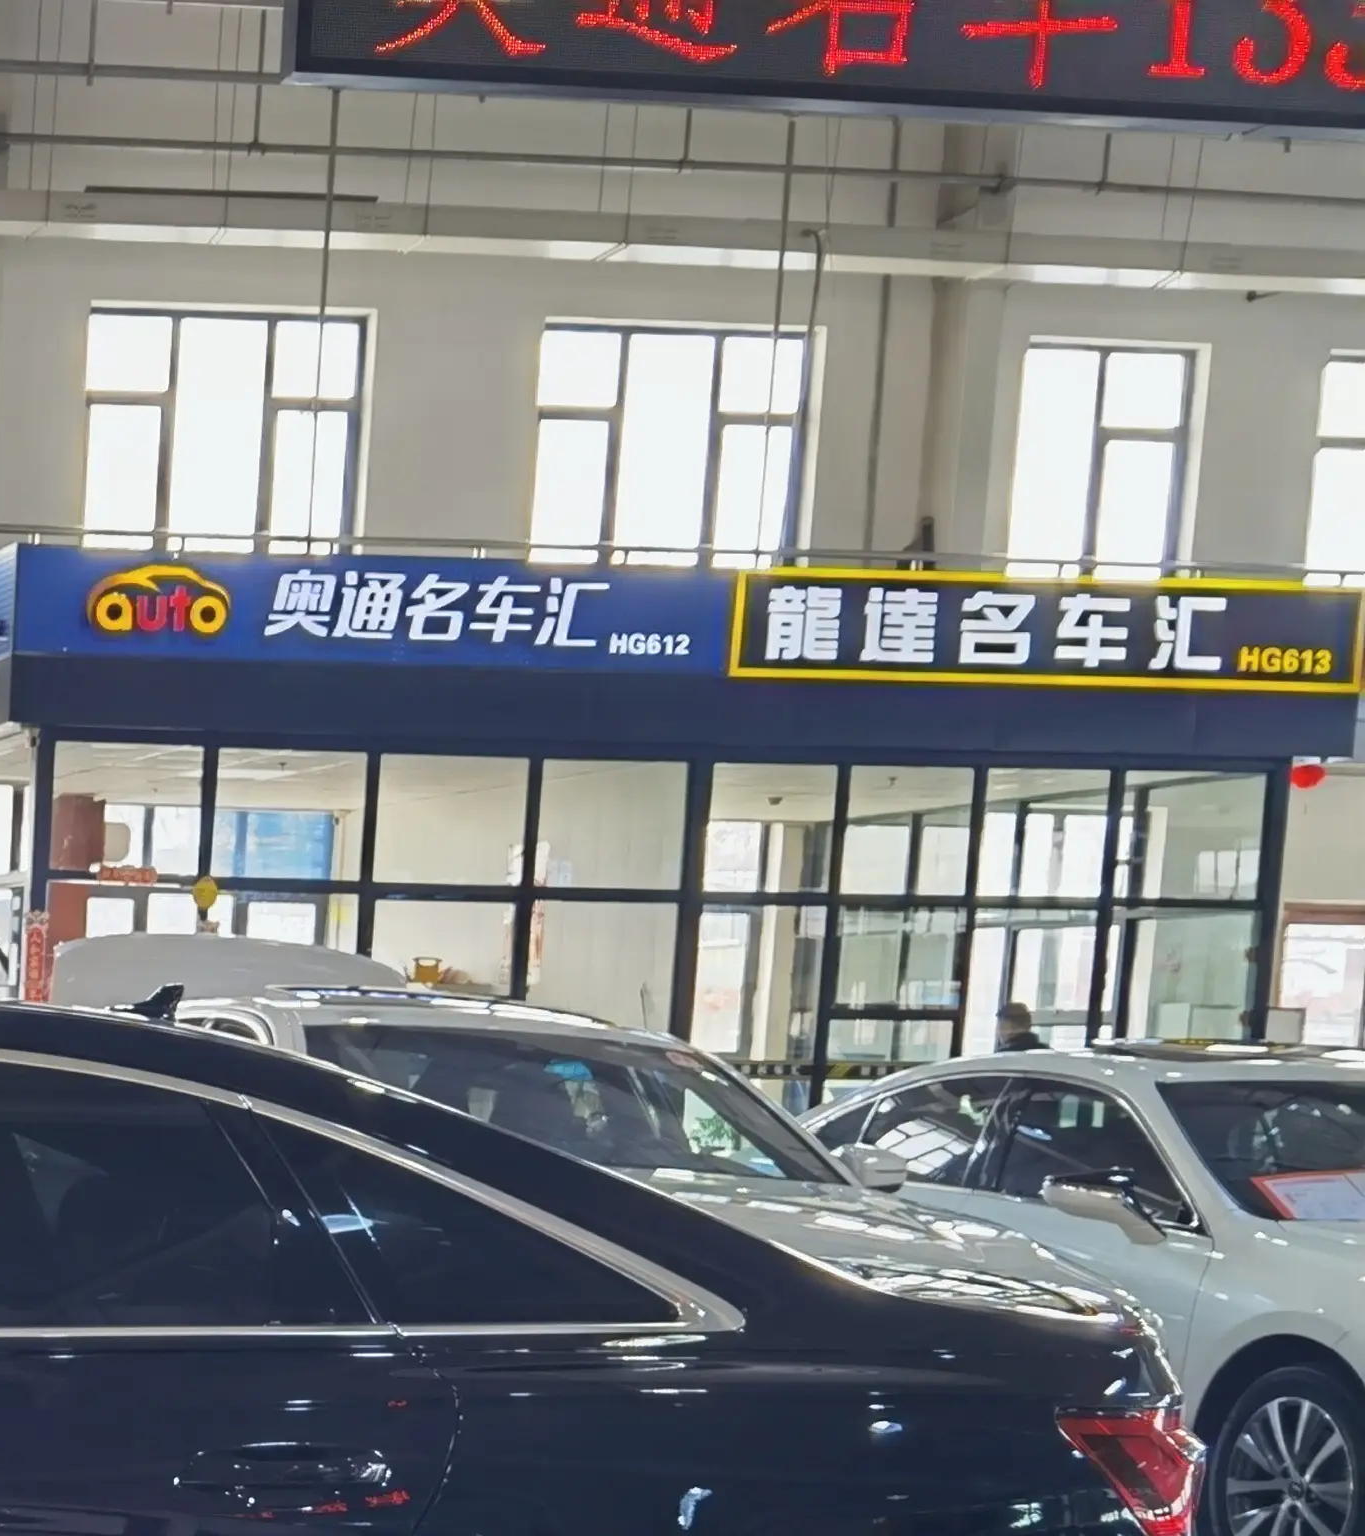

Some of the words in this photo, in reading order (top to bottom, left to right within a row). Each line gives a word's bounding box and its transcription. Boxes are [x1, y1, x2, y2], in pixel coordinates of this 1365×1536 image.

[264, 568, 611, 648] 奥通名车汇
[609, 632, 690, 657] HG612
[763, 585, 1229, 672] 龍達名车汇
[1237, 645, 1333, 676] HG613
